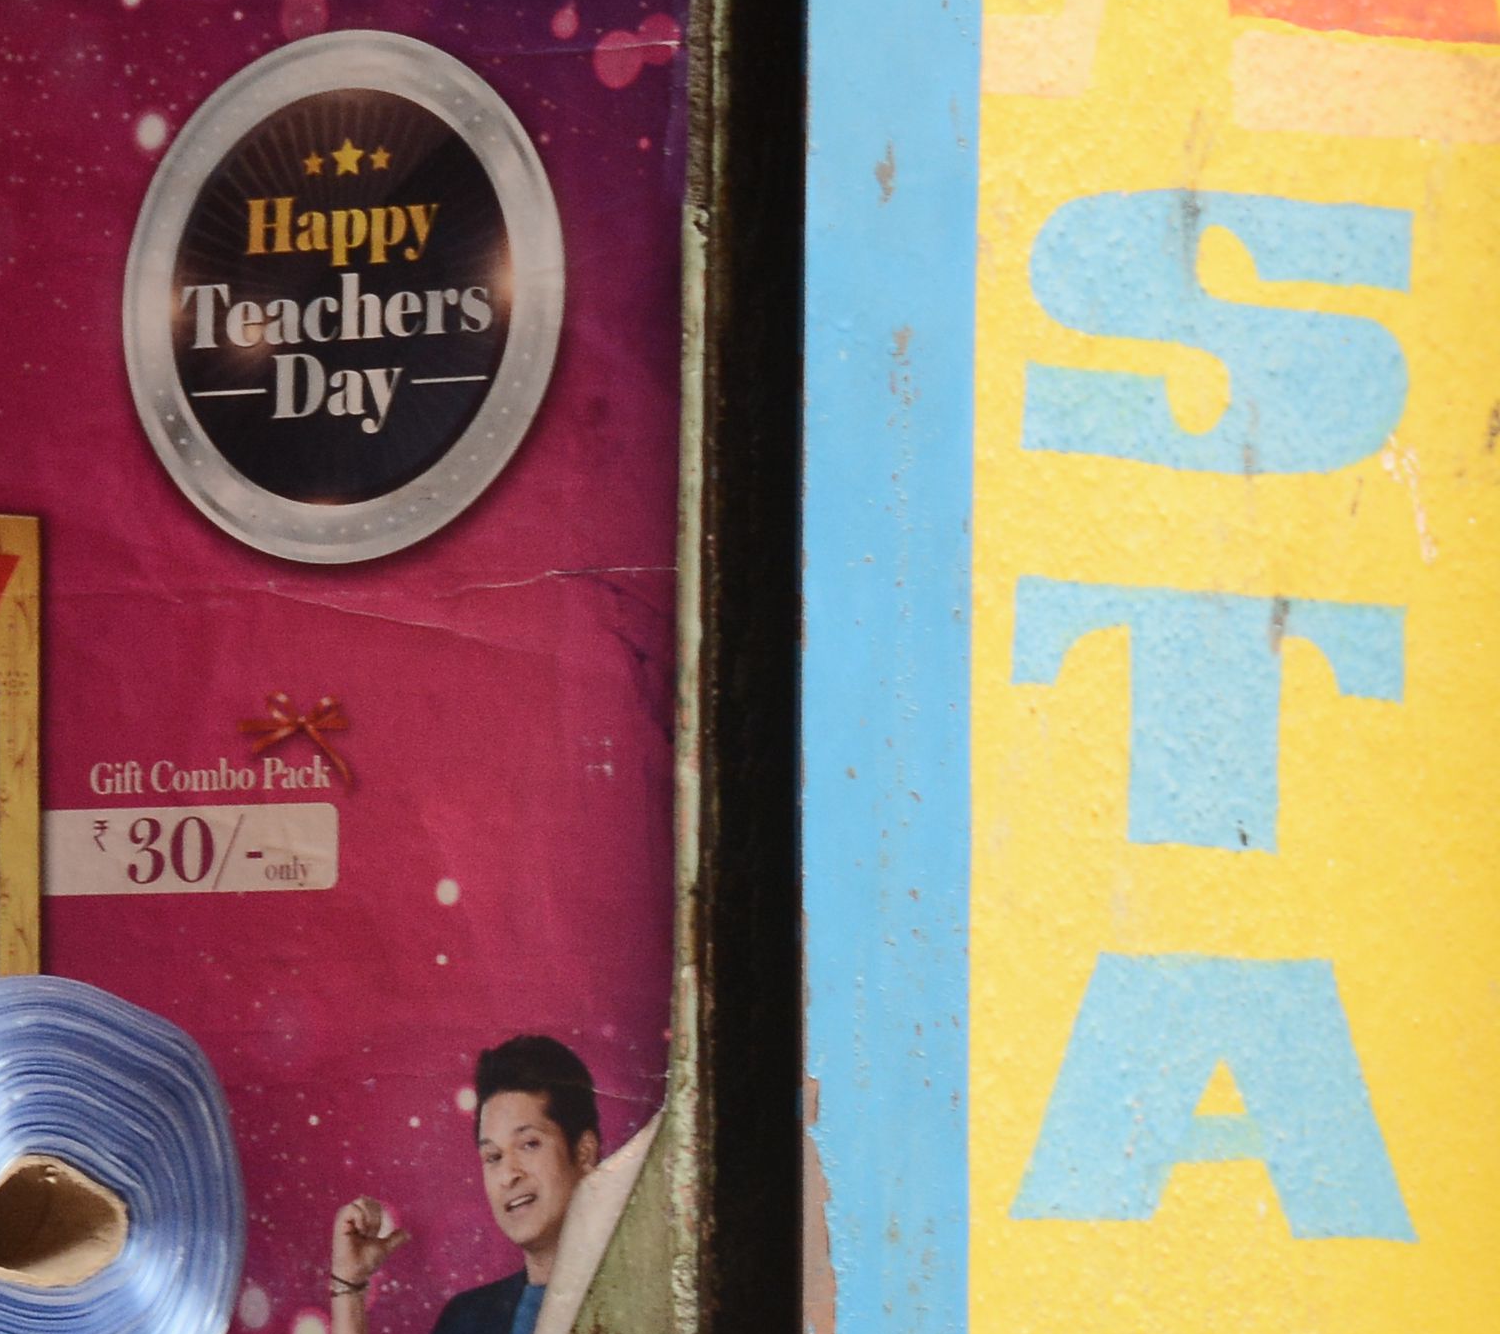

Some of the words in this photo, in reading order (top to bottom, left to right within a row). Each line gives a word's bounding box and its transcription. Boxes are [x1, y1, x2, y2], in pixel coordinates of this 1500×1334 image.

[244, 196, 441, 268] Happy
[180, 273, 494, 351] Teachers
[271, 352, 405, 435] Day
[89, 759, 145, 795] Gift
[149, 757, 257, 793] Combo
[262, 754, 331, 790] Pack
[264, 855, 311, 888] only
